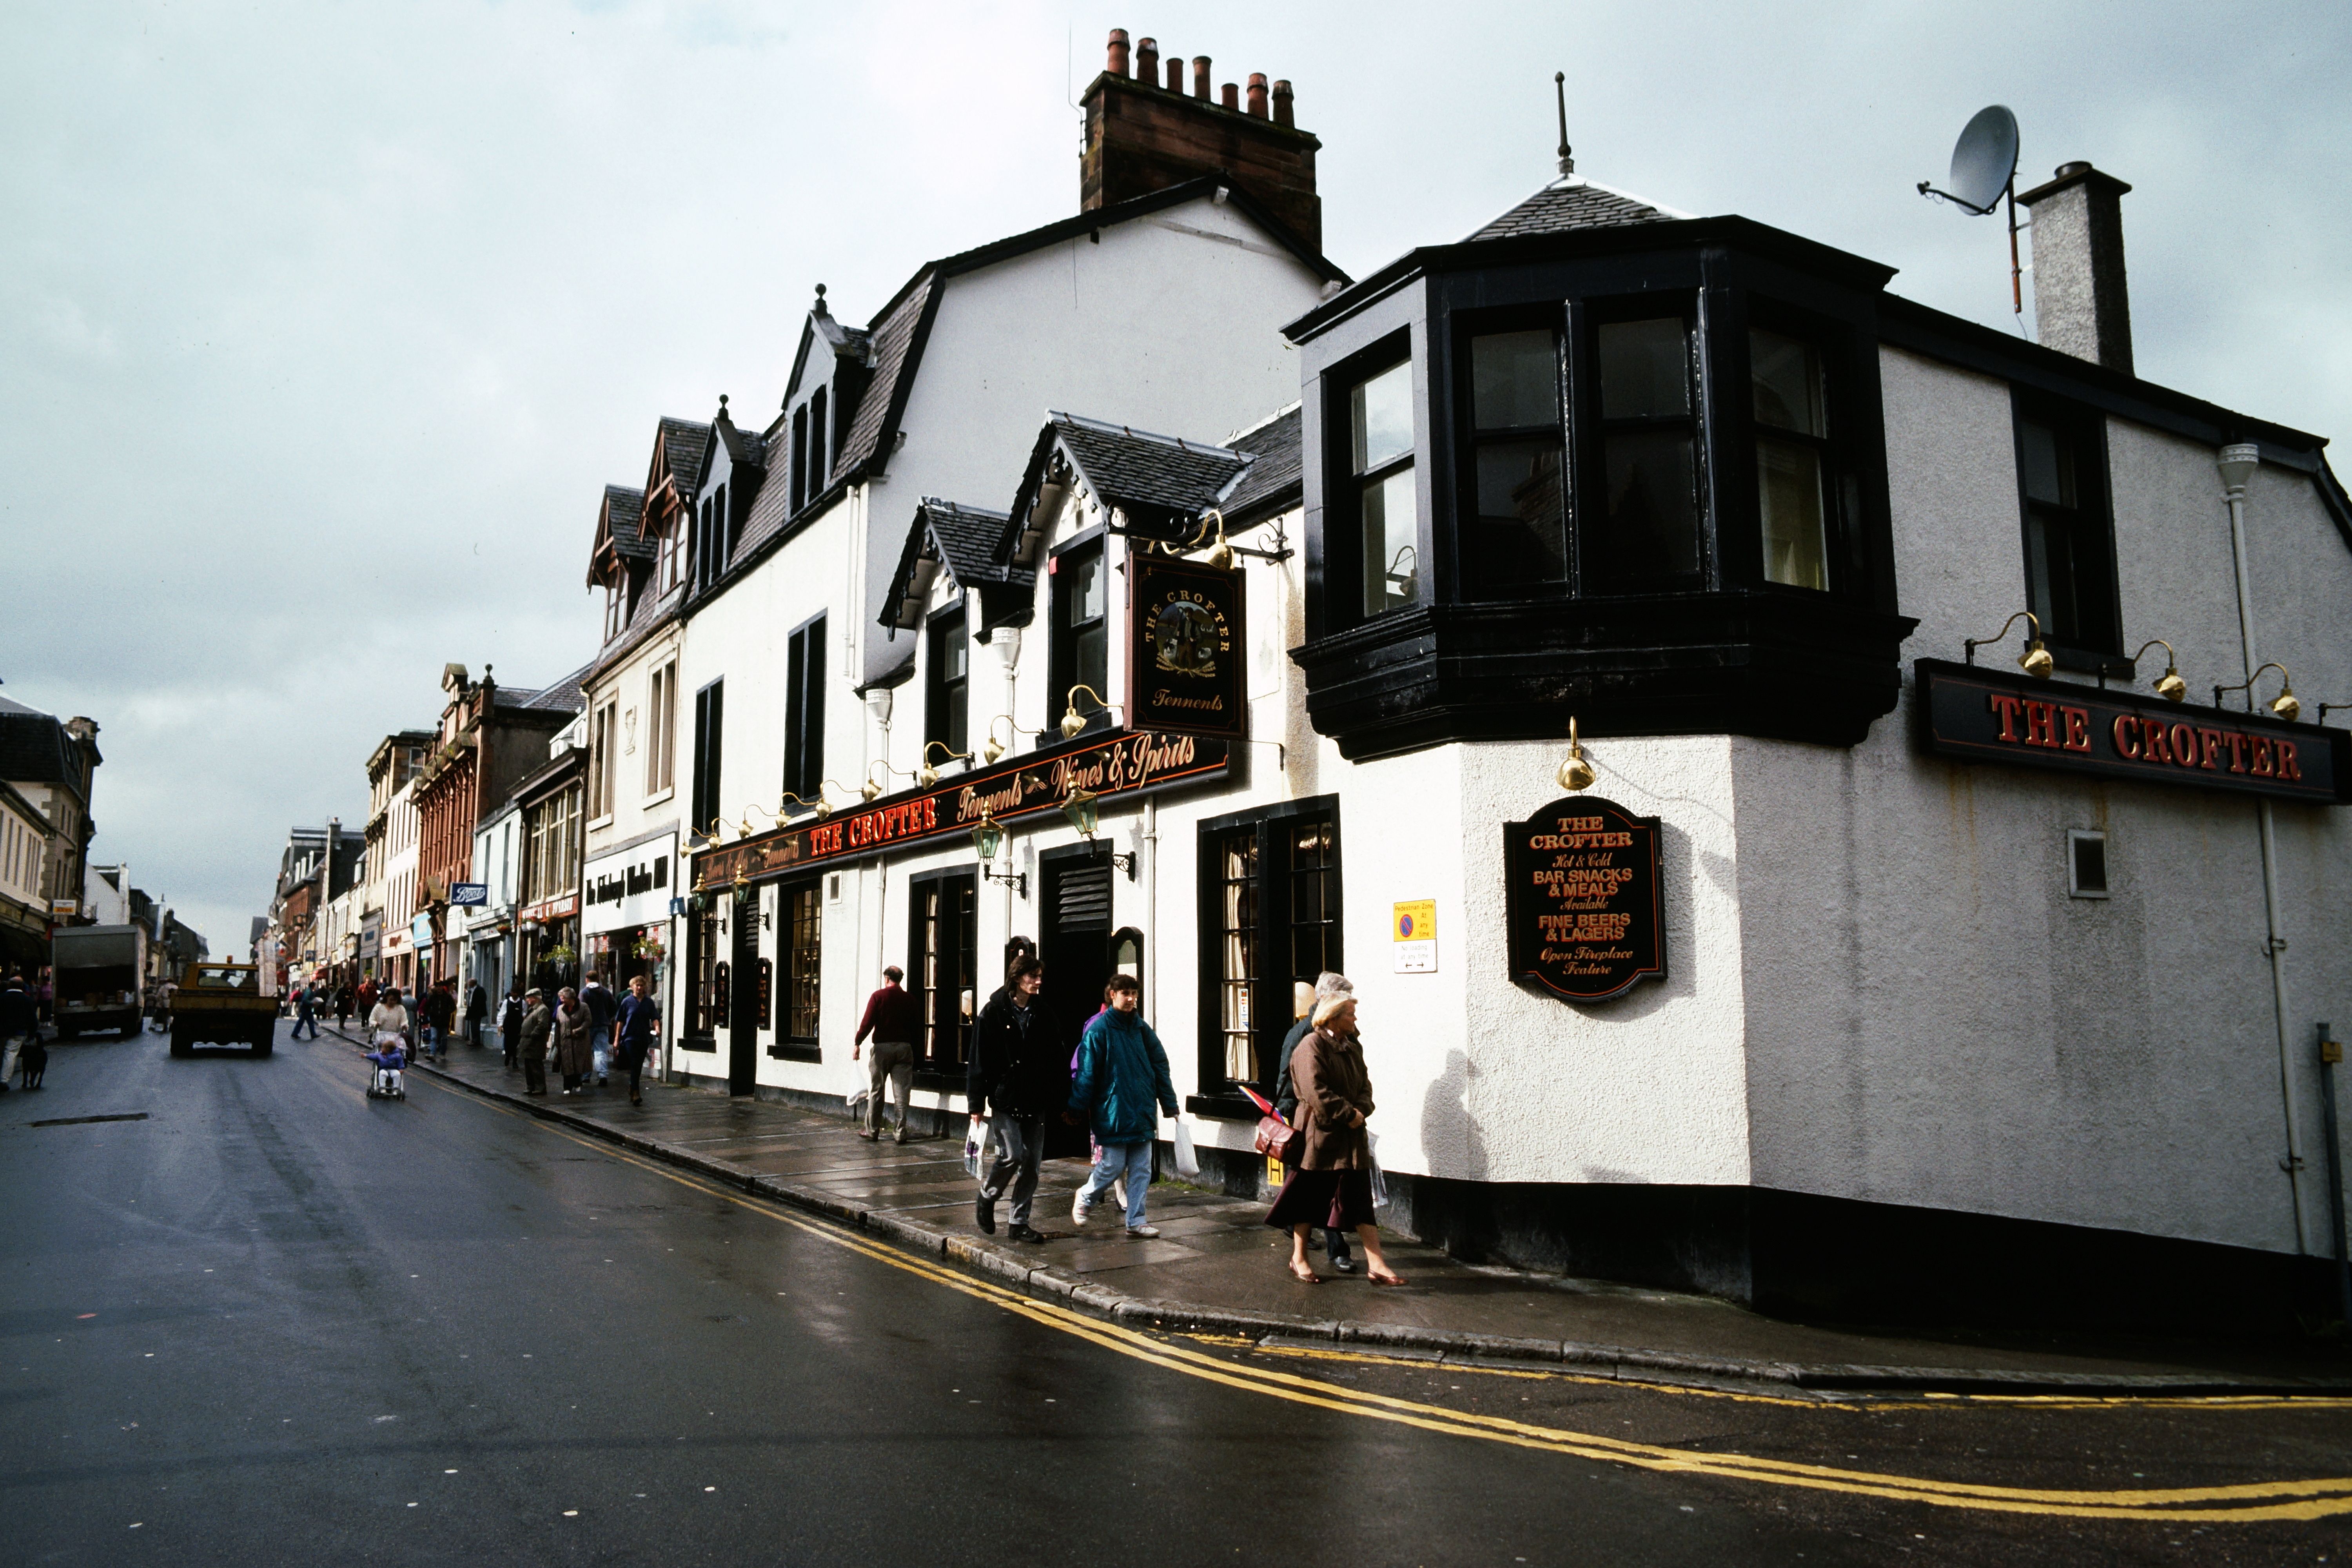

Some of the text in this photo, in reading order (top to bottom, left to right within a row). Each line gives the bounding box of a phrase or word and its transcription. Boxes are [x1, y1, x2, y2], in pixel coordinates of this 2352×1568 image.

[1145, 590, 1230, 652] THE CROFTER
[1152, 689, 1222, 710] Tennents
[1991, 694, 2301, 780] THE CROFTER
[810, 823, 842, 856] THE
[849, 797, 937, 847] CROFTER
[957, 773, 1022, 822] Tennents
[1051, 756, 1103, 798] Wines
[1108, 742, 1127, 790] &
[1129, 734, 1194, 789] Spirits
[1557, 816, 1603, 832] THE
[1530, 832, 1633, 849] CROFTER
[1552, 852, 1612, 867] Hot & Cold
[1533, 868, 1632, 884] BAR SNACKS
[453, 887, 485, 902] Boots
[1548, 882, 1618, 897] & MEALS
[1560, 896, 1609, 910] Available
[1539, 913, 1631, 928] FINE BEERS
[1546, 927, 1625, 942] & LAGERS
[1540, 947, 1633, 963] Open Fireplace
[1563, 962, 1612, 975] Feature
